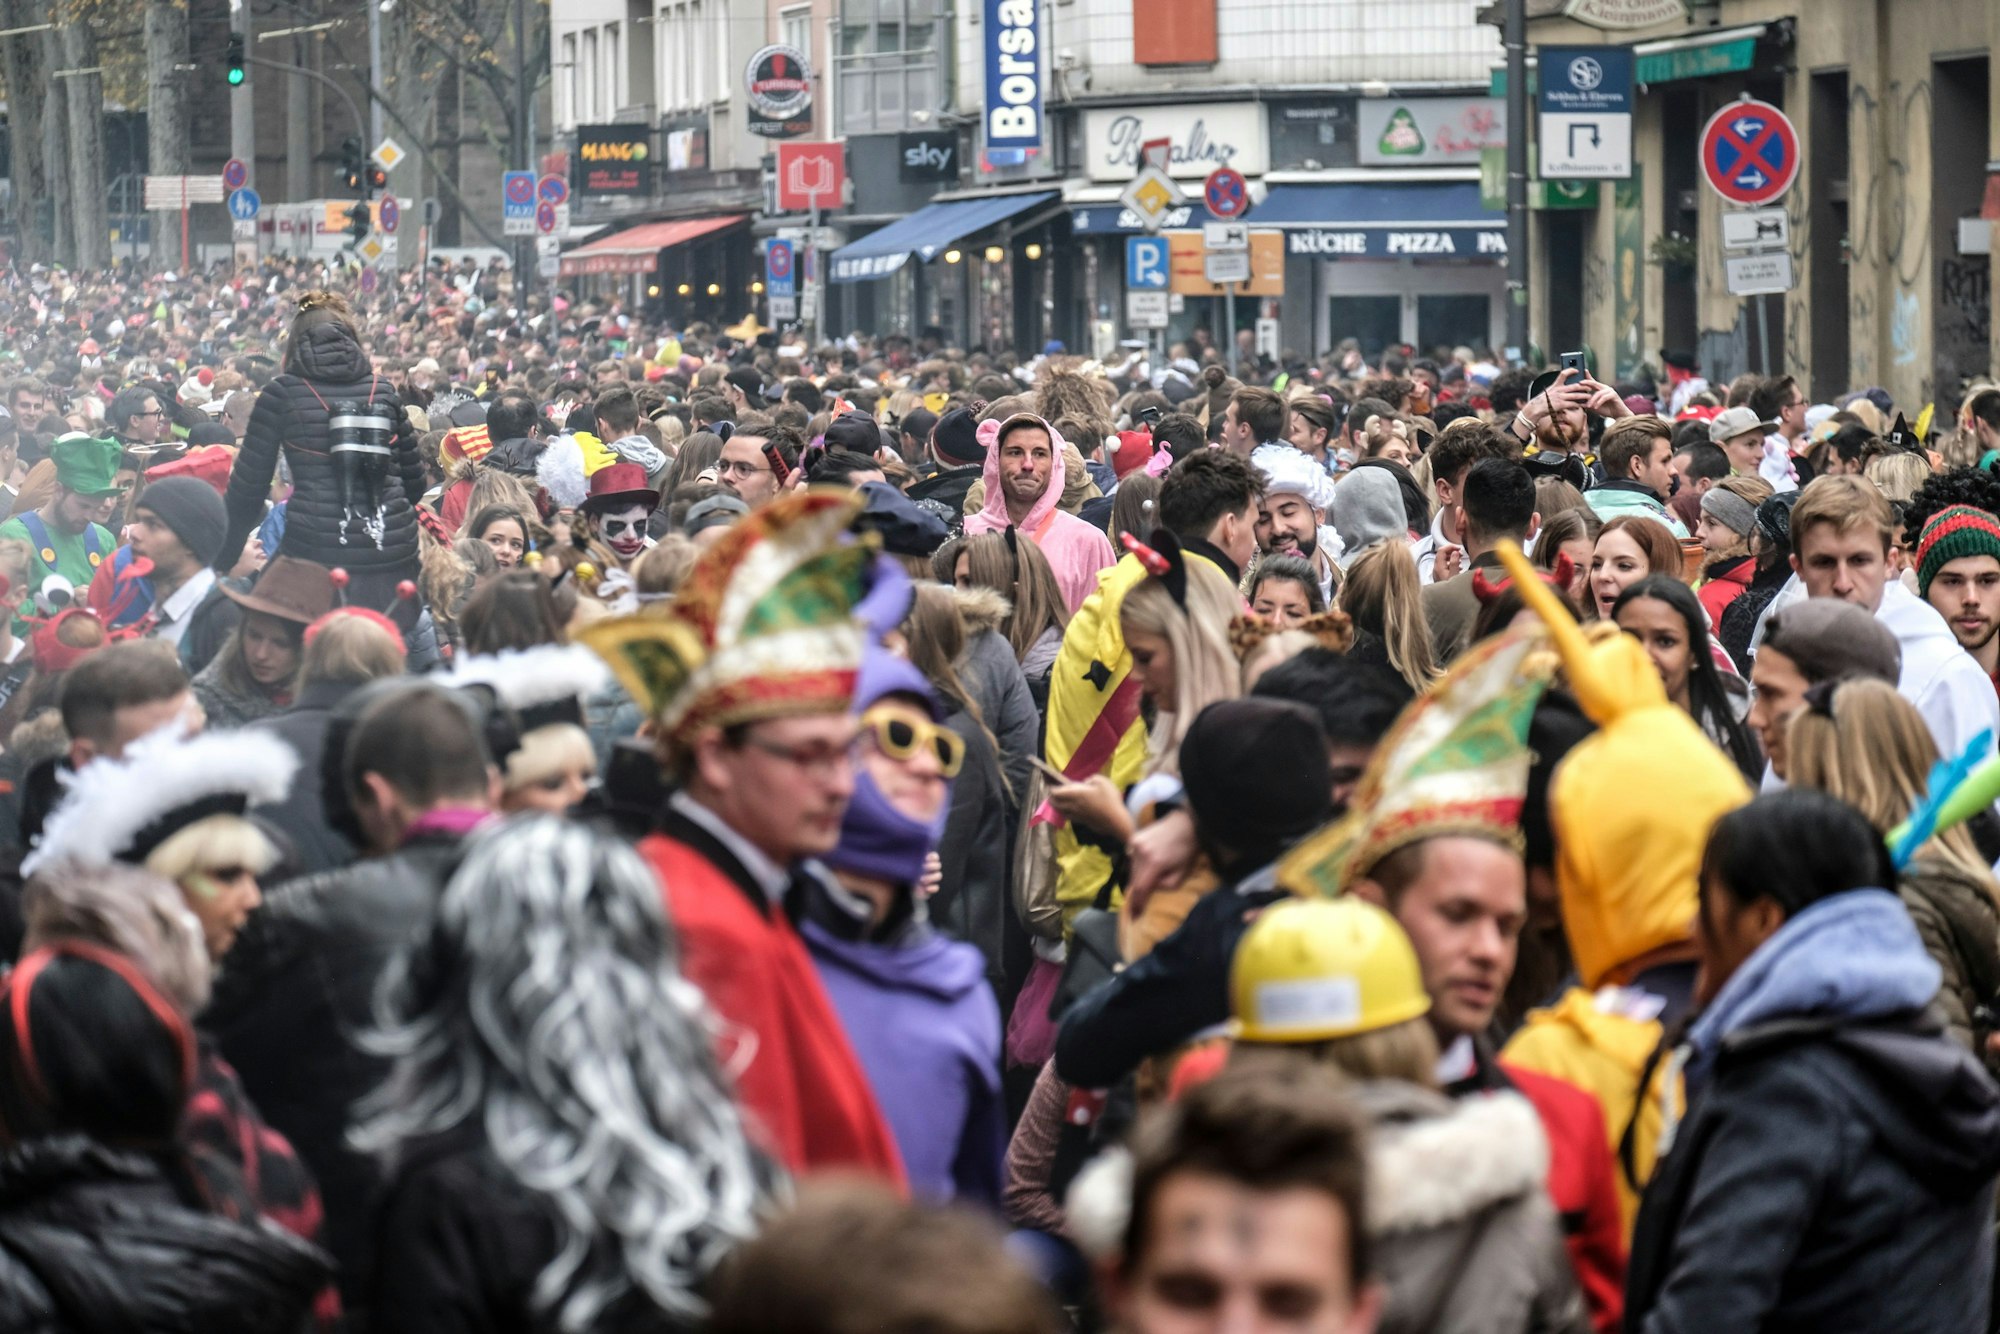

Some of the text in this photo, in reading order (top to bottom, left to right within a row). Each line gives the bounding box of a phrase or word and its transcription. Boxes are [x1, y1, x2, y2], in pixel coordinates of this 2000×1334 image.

[1584, 2, 1678, 22] Kleinmann
[581, 142, 648, 161] MANGO
[905, 141, 952, 170] sky
[1290, 229, 1367, 253] KÜCHE
[1386, 232, 1456, 253] PIZZA
[1136, 243, 1160, 283] P
